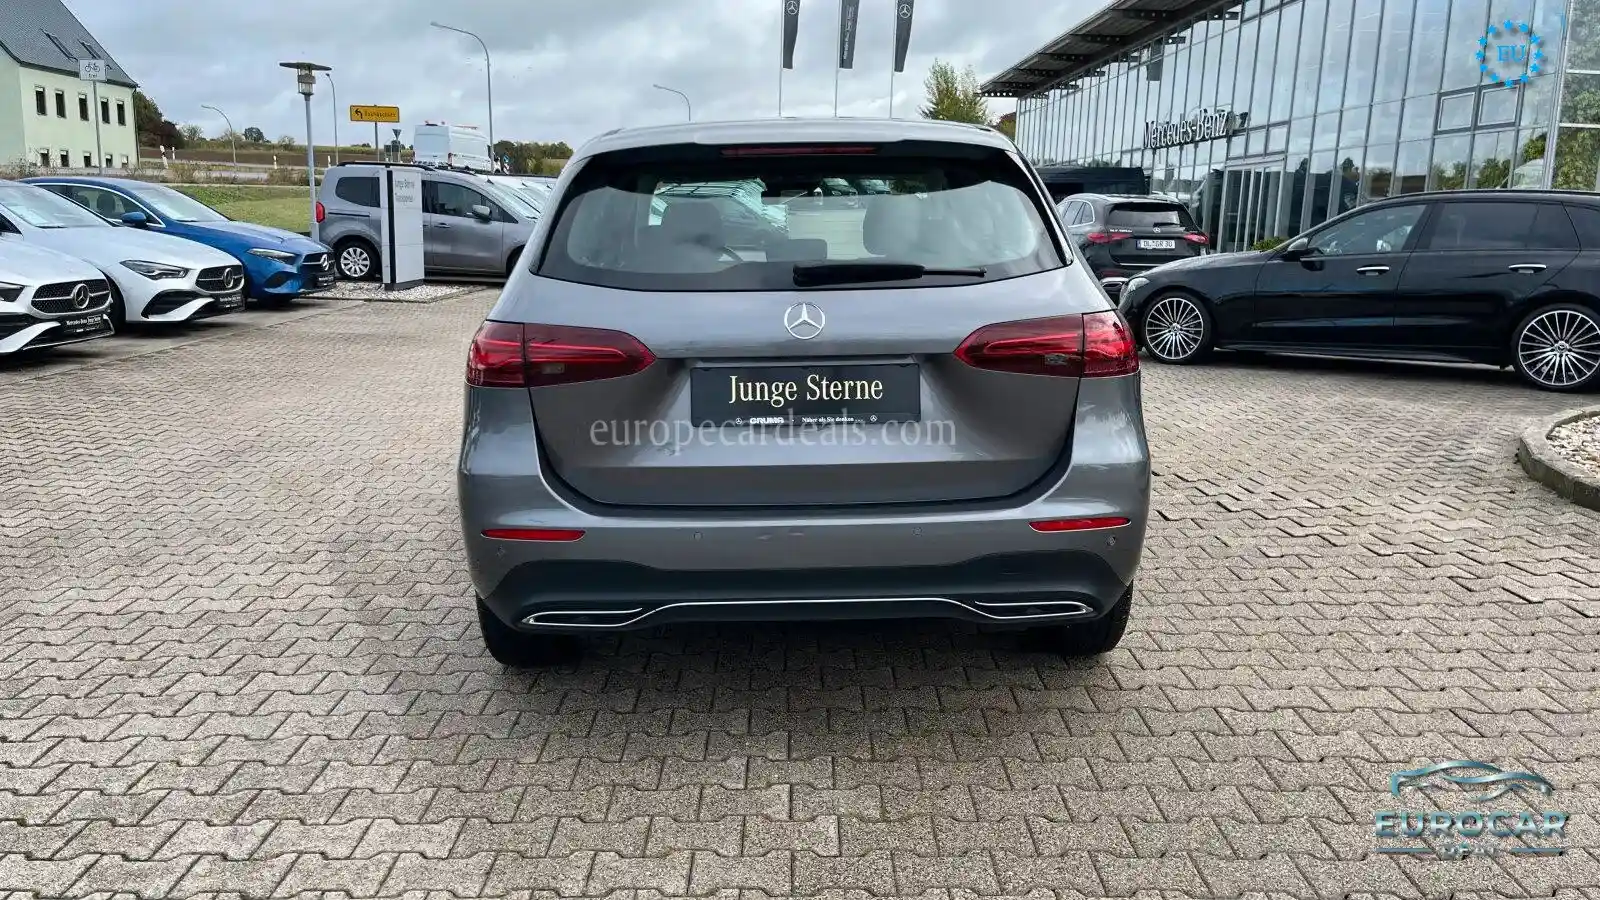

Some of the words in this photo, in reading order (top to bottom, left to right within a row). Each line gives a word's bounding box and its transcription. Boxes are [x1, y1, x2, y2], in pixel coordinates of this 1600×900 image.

[1143, 109, 1228, 149] Mercedes-Benz
[729, 375, 797, 408] Junge
[806, 374, 883, 401] Sterne
[749, 417, 784, 425] GRUMA
